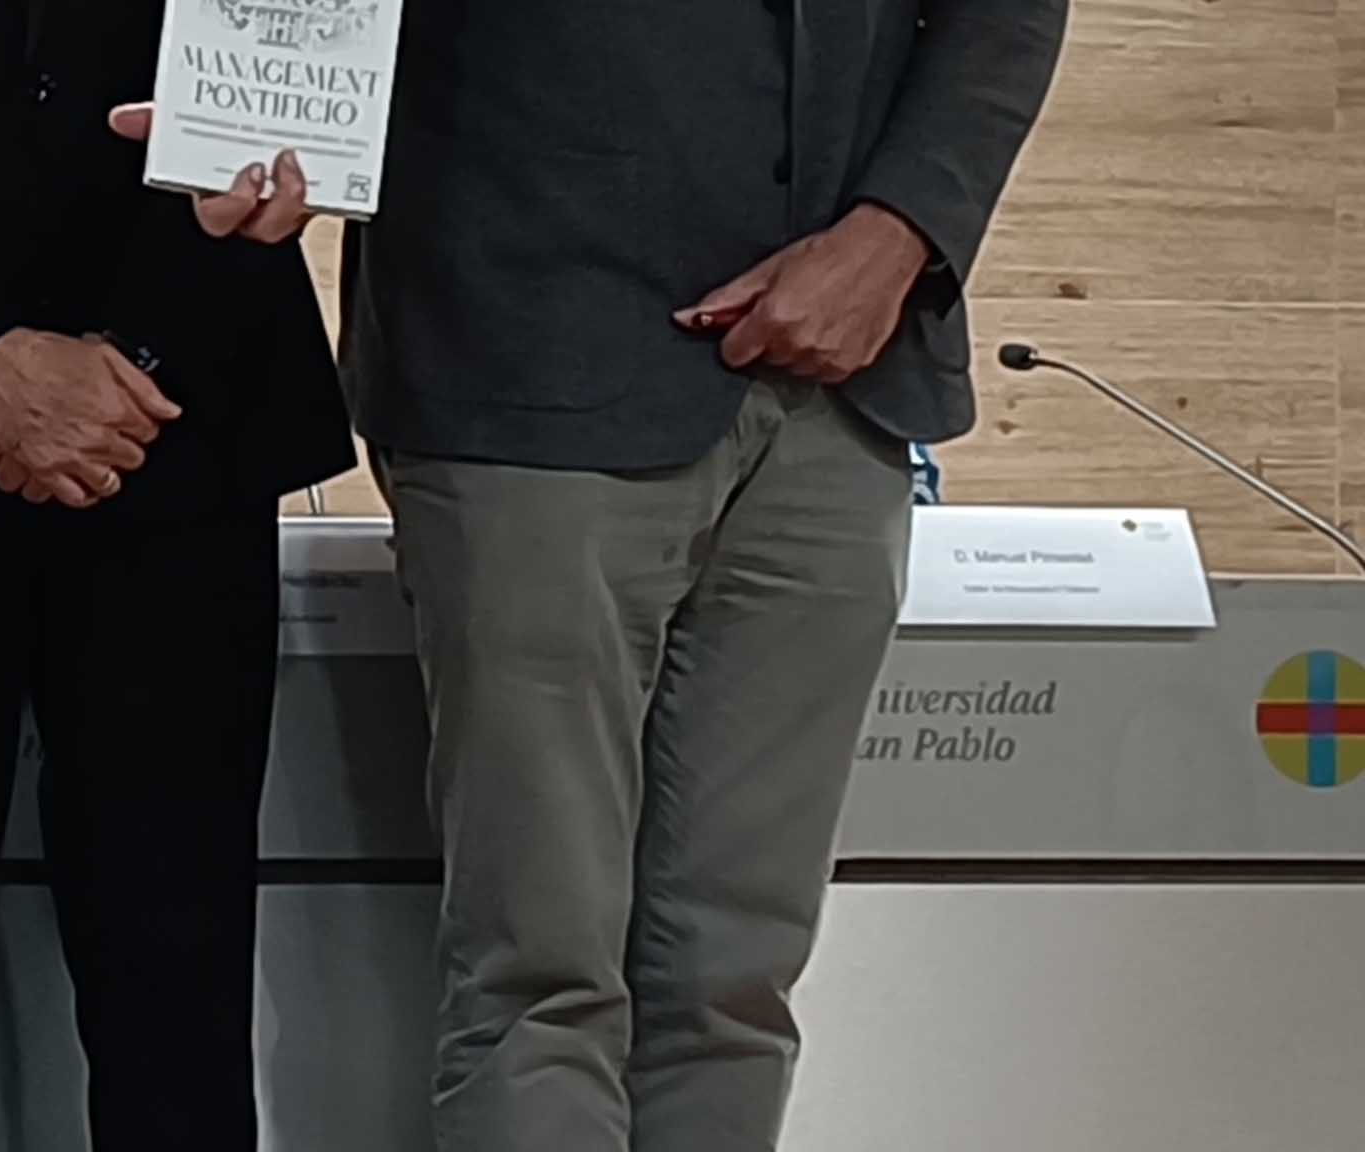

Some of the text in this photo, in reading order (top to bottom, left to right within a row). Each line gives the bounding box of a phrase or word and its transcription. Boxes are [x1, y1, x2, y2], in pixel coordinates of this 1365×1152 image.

[181, 44, 380, 97] MANAGEMENT
[194, 79, 358, 127] PONTIFICIO
[855, 726, 1016, 762] an Pablo
